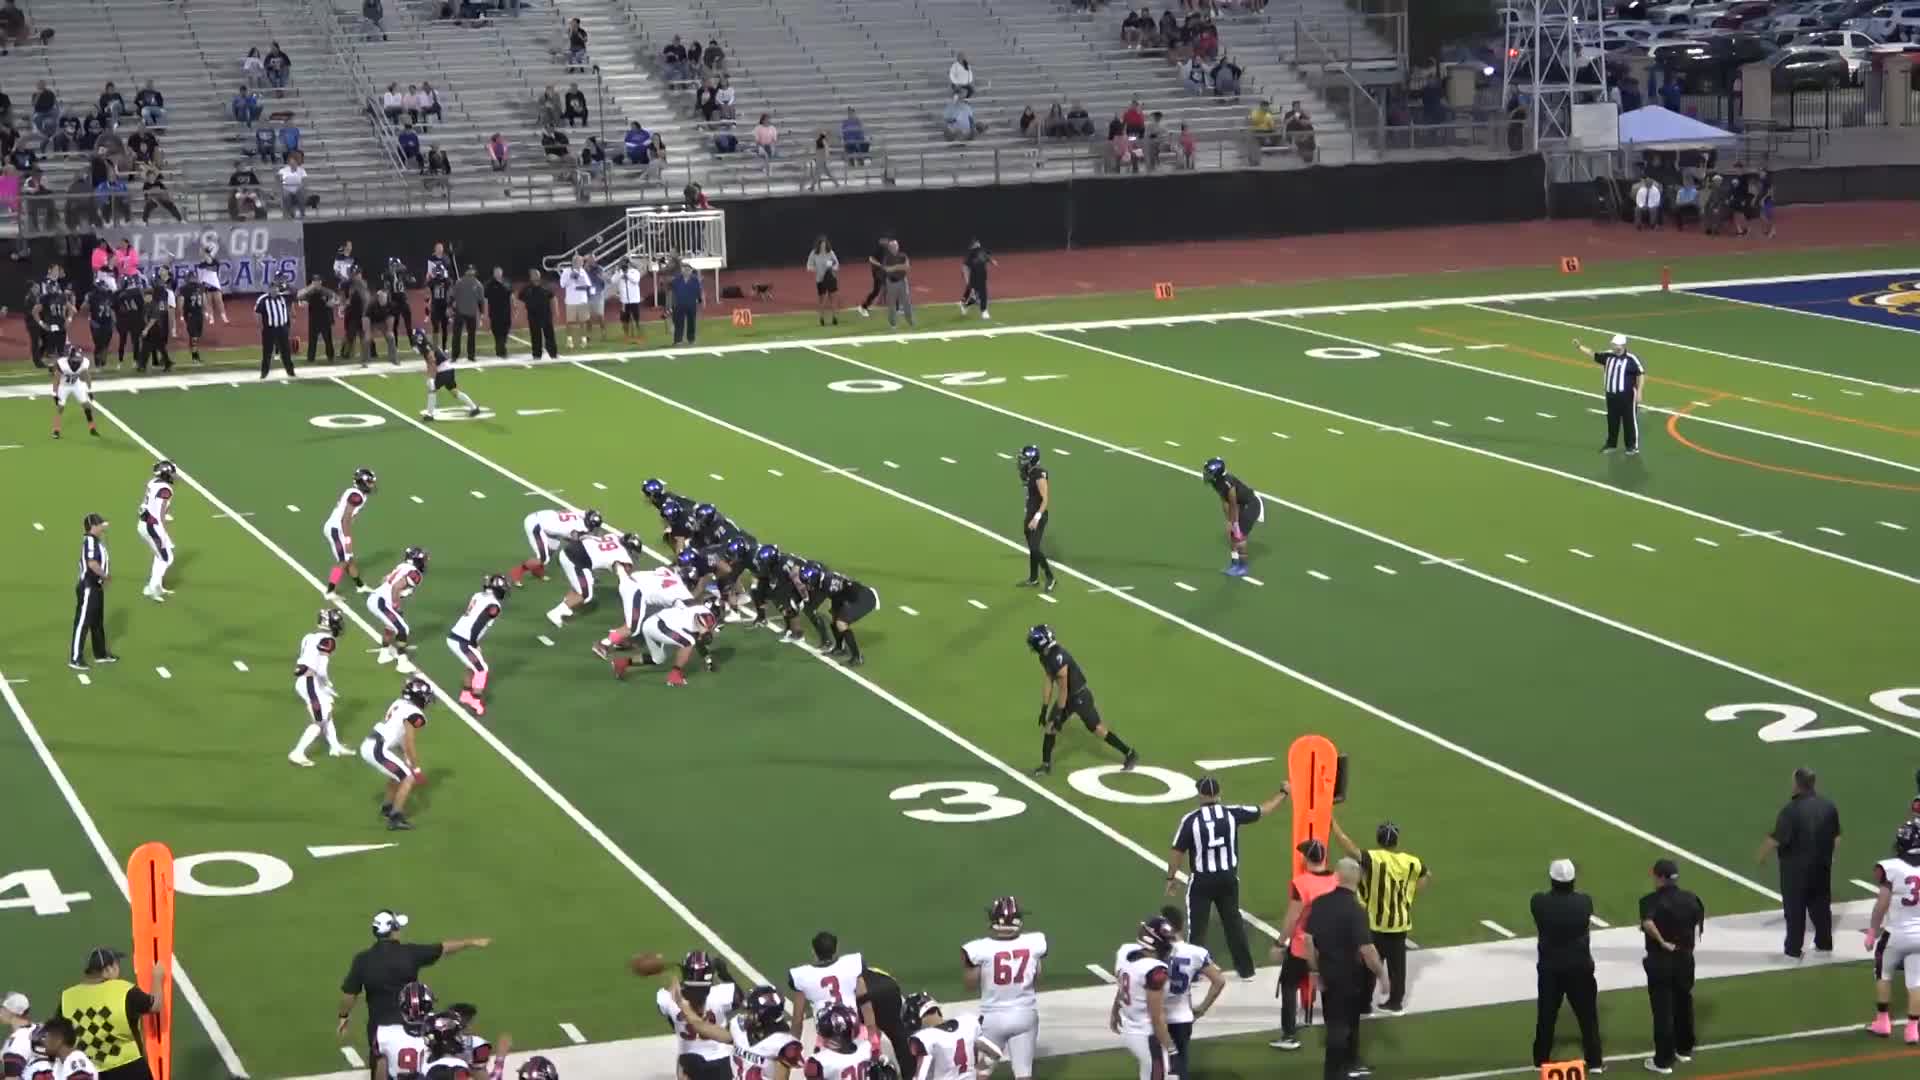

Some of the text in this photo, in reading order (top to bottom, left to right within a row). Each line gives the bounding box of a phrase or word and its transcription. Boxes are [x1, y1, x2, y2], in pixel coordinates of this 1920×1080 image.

[132, 226, 269, 261] LET'S GO
[1159, 285, 1171, 297] 10
[735, 310, 750, 326] 20
[889, 764, 1198, 823] 30
[1207, 821, 1225, 848] L
[993, 948, 1031, 986] 67
